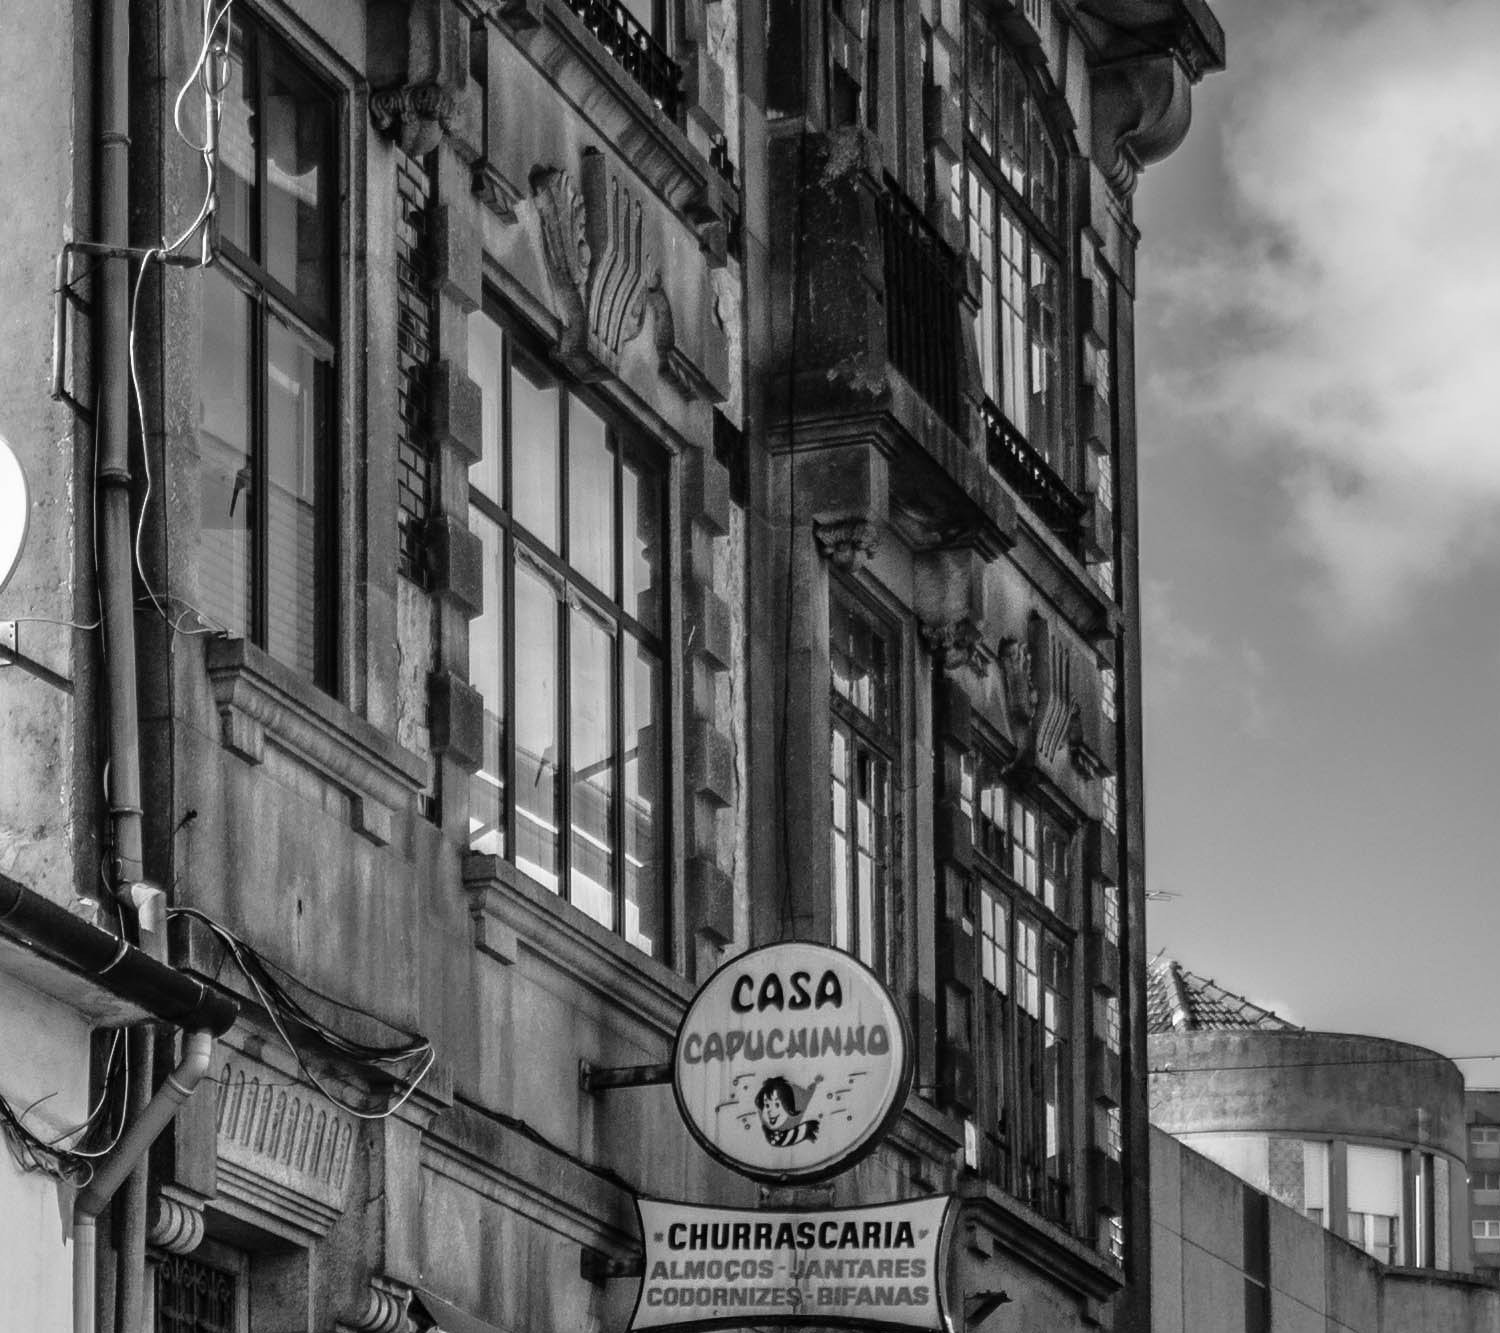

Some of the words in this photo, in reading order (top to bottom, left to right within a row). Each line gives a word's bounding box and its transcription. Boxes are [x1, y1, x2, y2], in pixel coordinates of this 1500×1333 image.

[730, 969, 843, 1014] CASA
[667, 1221, 916, 1252] CHURRASCARIA
[650, 1259, 775, 1283] ALMOÇOS
[789, 1257, 927, 1280] JANTARES
[645, 1286, 800, 1308] CODORNIZES
[816, 1286, 931, 1308] BIFANAS
